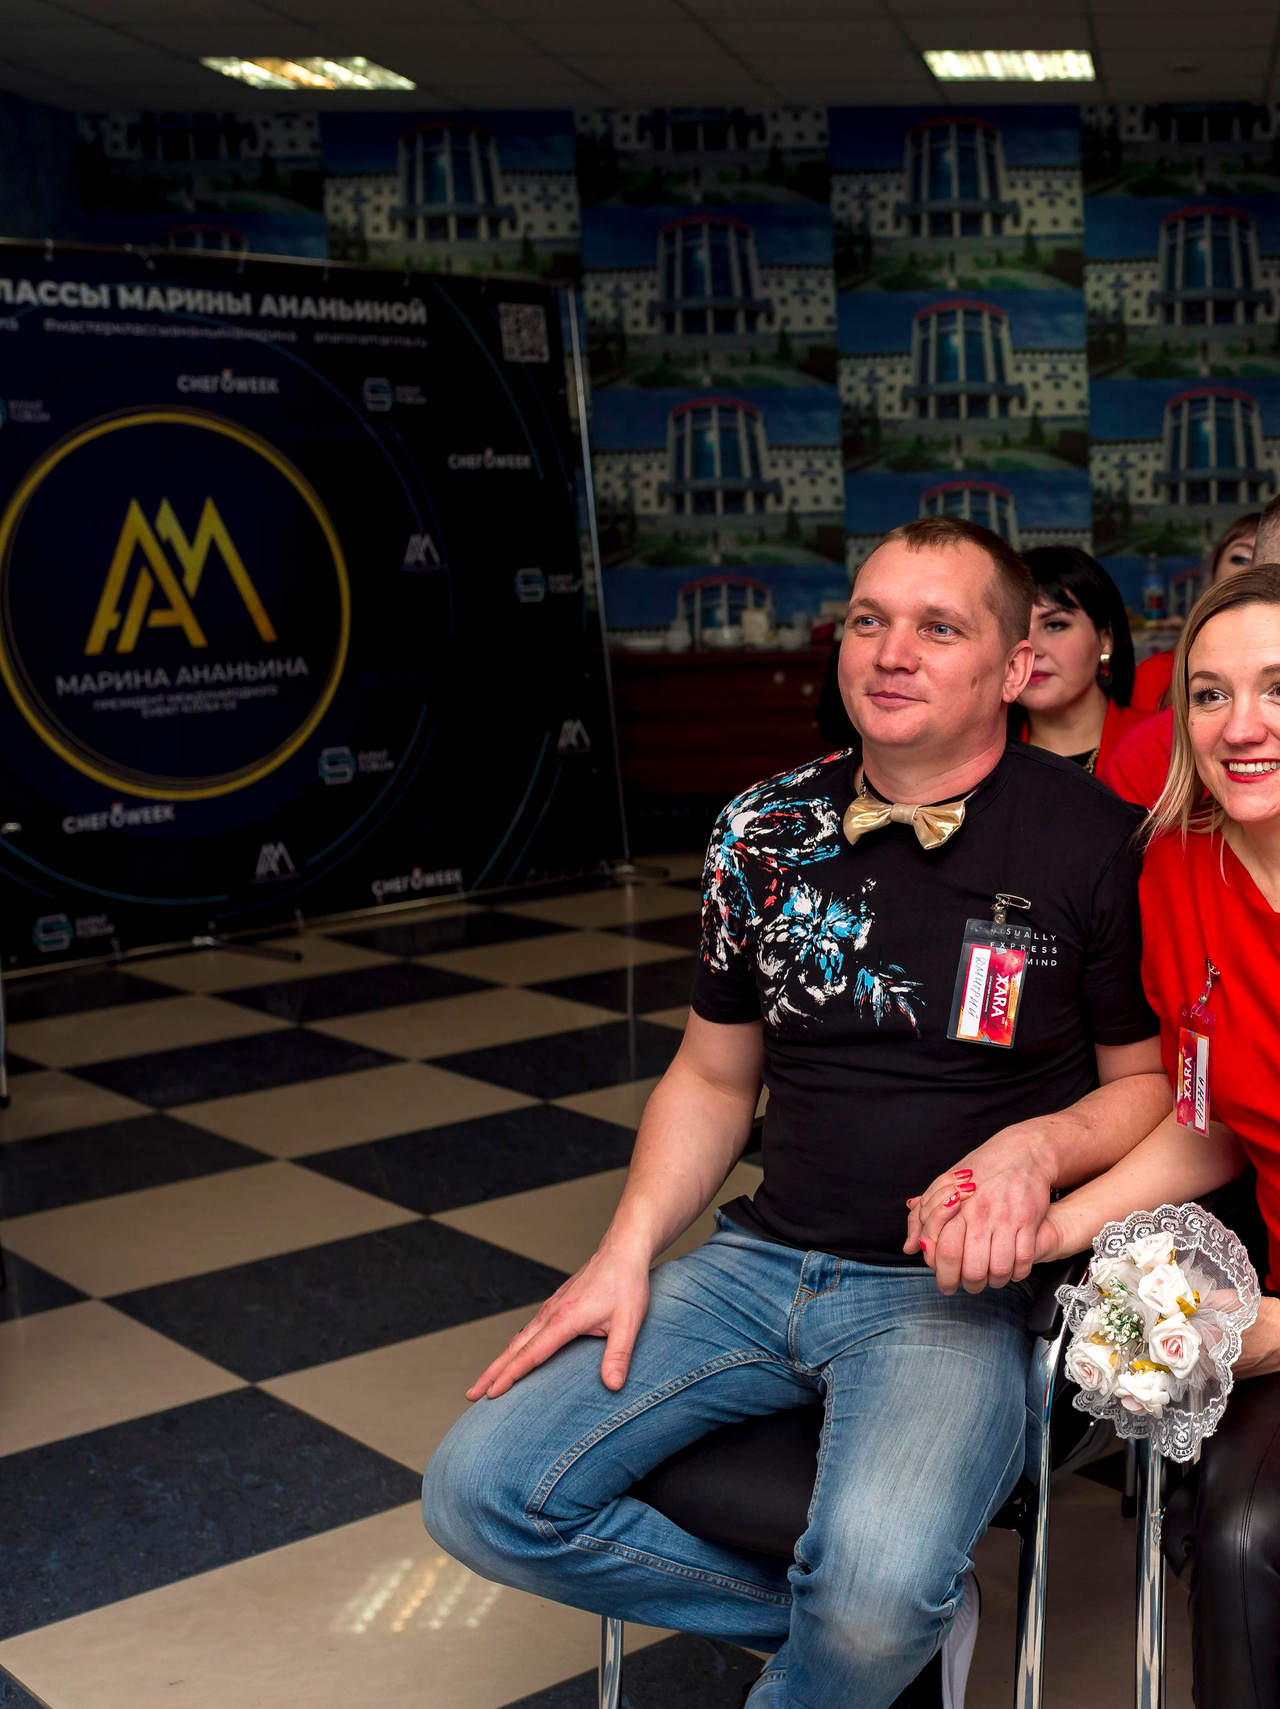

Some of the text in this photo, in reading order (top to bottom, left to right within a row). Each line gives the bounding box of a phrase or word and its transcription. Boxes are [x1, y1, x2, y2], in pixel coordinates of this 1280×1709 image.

[117, 284, 252, 317] МАРИНЫ
[258, 291, 428, 326] АНАНЬИНОЙ
[55, 656, 310, 697] МАРИНА АНАНЬИНА
[990, 941, 1058, 954] EXPRESS
[1026, 958, 1057, 967] MIND
